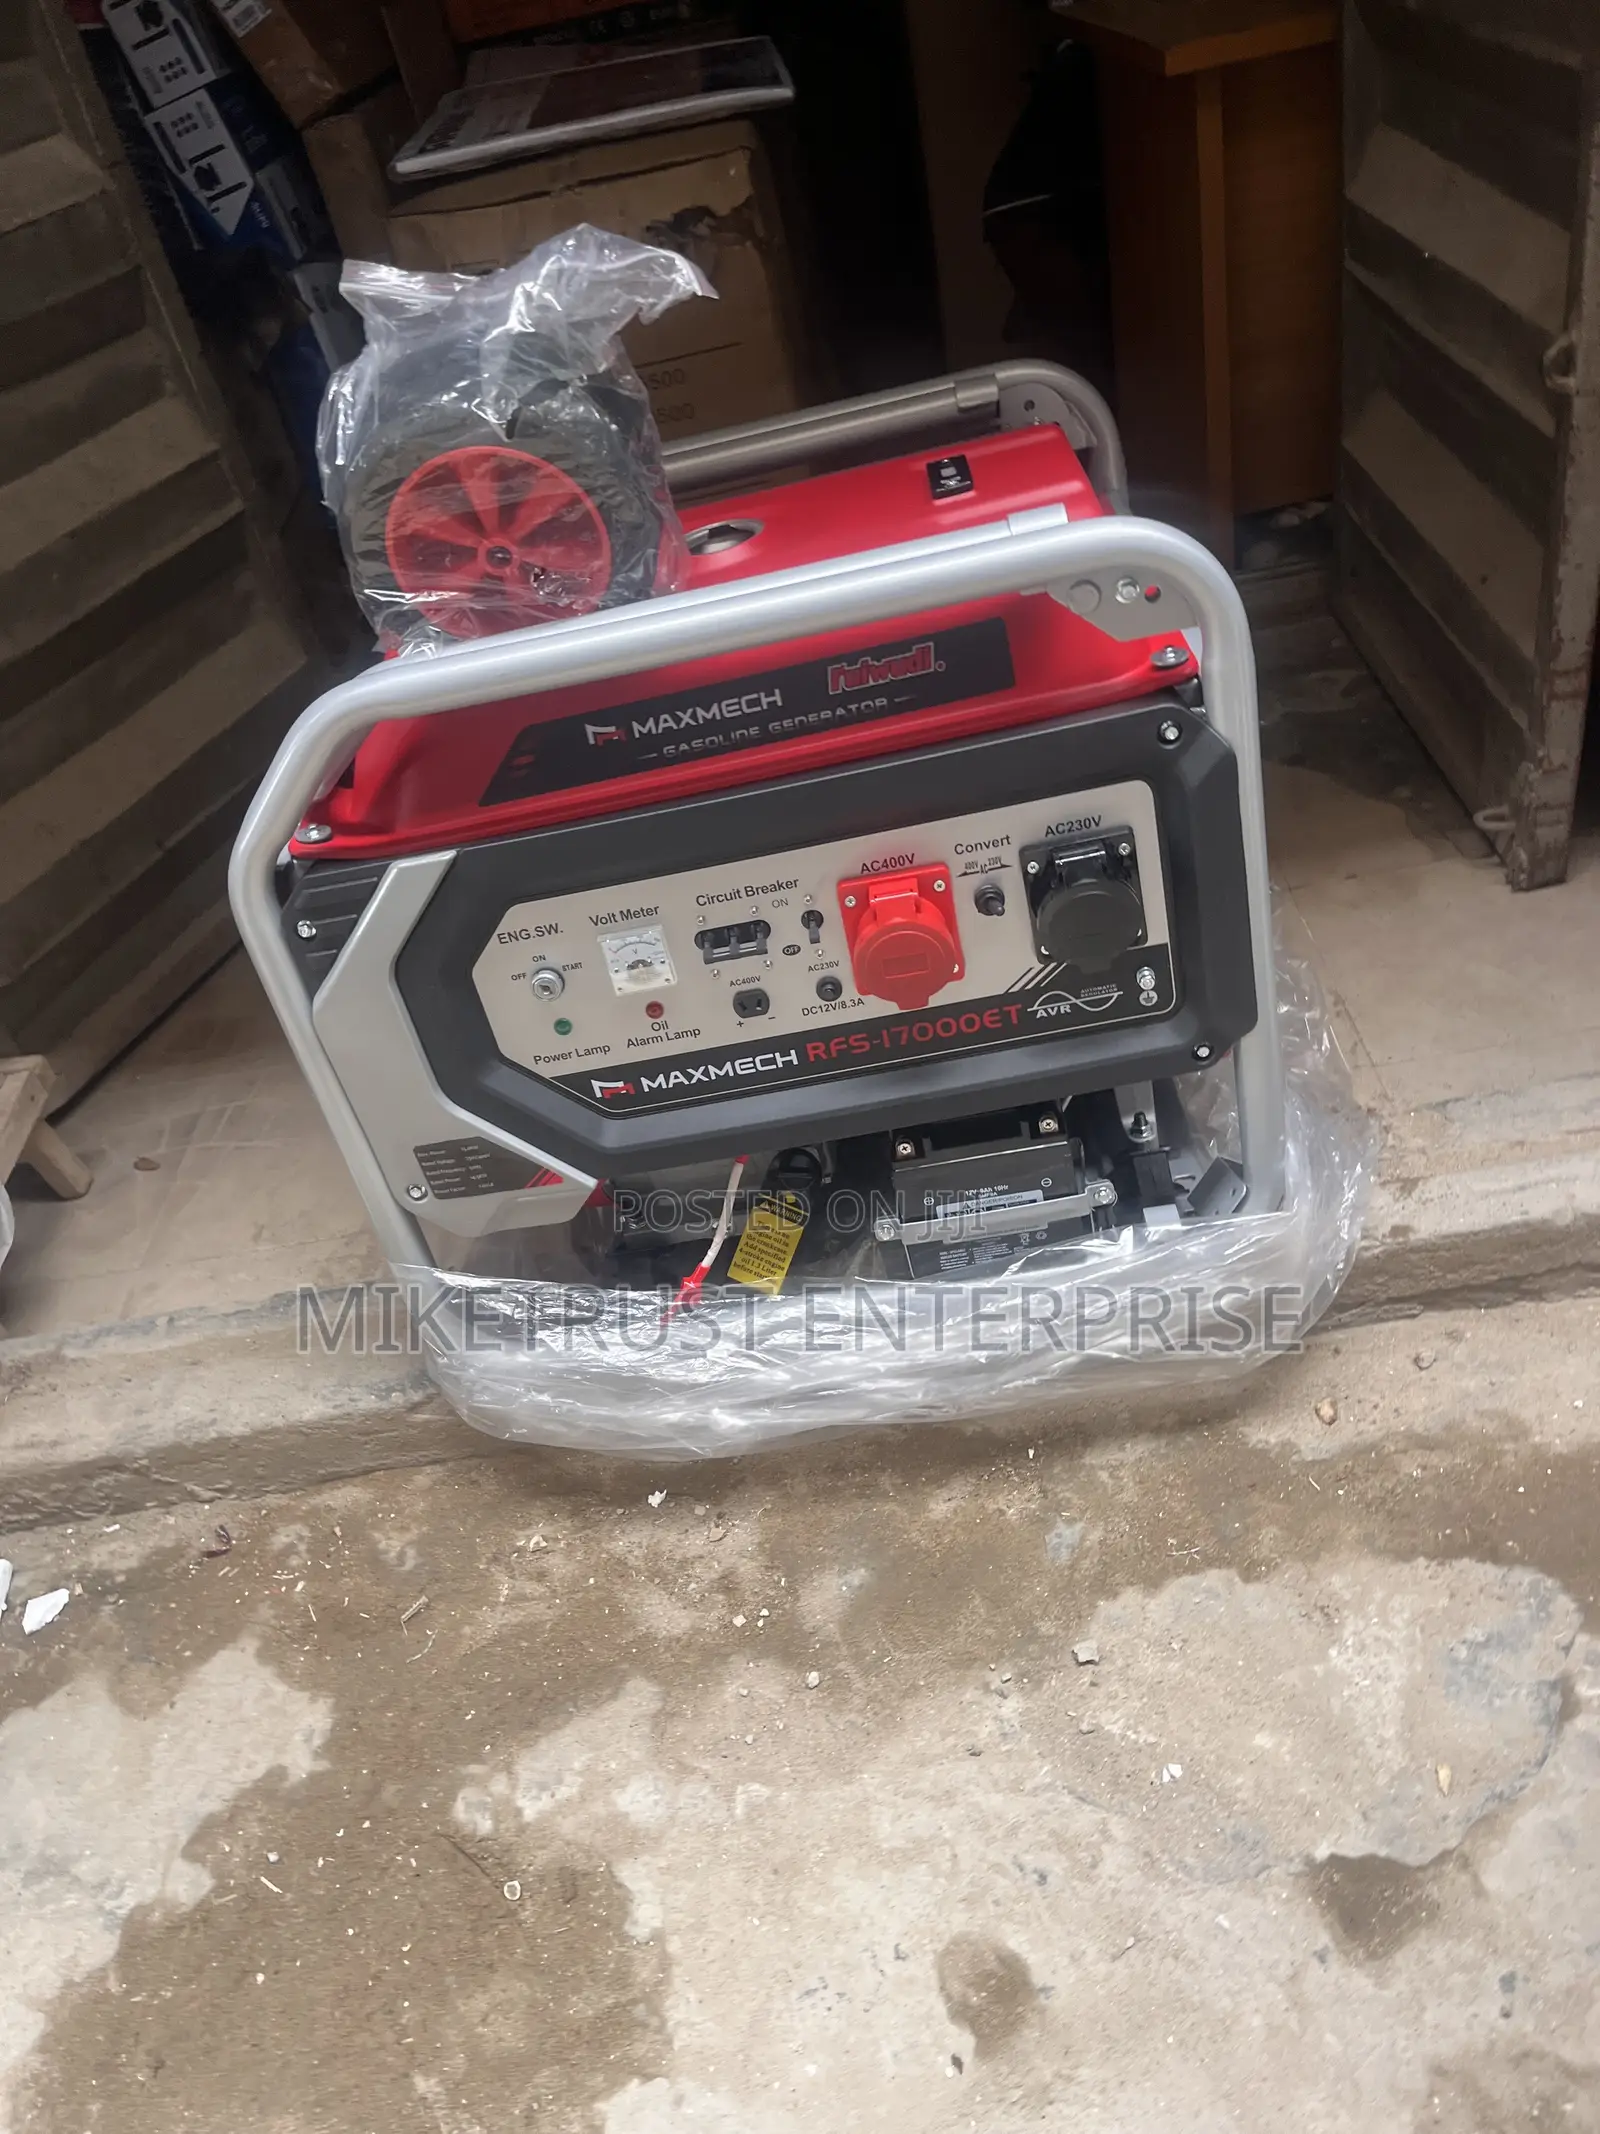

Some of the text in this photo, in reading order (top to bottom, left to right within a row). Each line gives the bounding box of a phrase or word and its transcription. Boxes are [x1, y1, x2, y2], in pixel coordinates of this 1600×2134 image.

[631, 688, 783, 739] MAXMECH
[662, 698, 888, 758] GASOLINE GENERATOR
[1044, 815, 1103, 838] AC230V
[954, 835, 1012, 856] Convert
[860, 853, 916, 875] AC400V
[696, 878, 800, 907] Circuit Breaker
[771, 898, 789, 909] ON
[589, 905, 660, 927] Volt Meter
[497, 922, 564, 945] ENG.SW.
[532, 954, 547, 963] ON
[784, 946, 799, 955] OFF
[511, 972, 527, 982] OFF
[562, 962, 583, 972] START
[807, 960, 840, 973] AC230V
[729, 975, 762, 988] AC400V
[801, 997, 865, 1017] DC12V/8.3A
[1036, 1004, 1071, 1019] AVR
[651, 1020, 669, 1032] Oil
[626, 1027, 701, 1049] Alarm Lamp
[640, 1002, 1023, 1093] MAXMECH RFS-17000ET
[533, 1043, 611, 1066] Power Lamp
